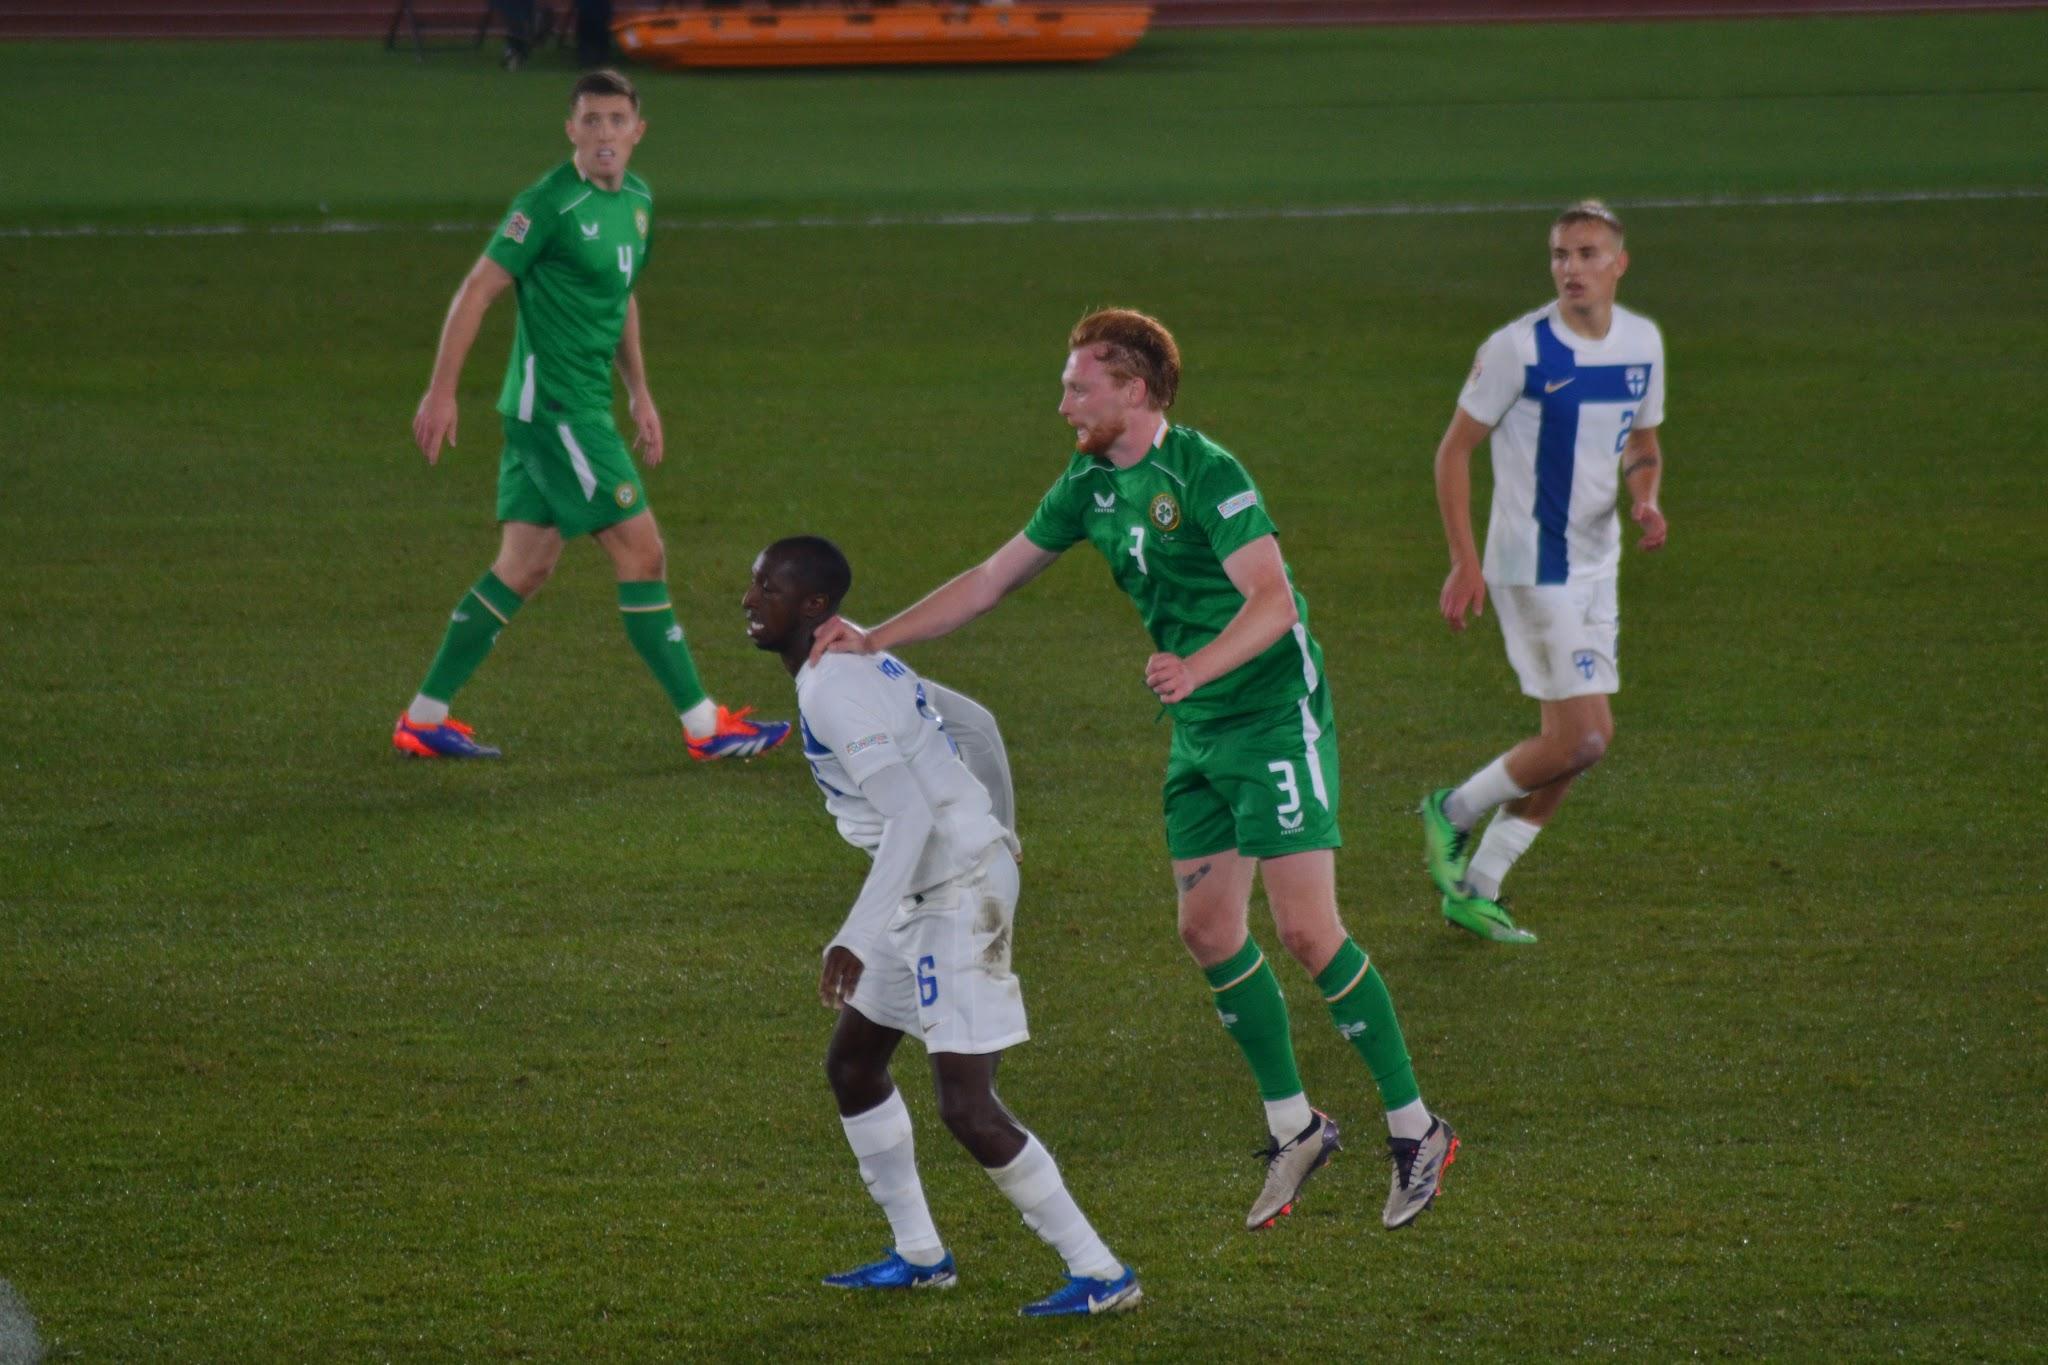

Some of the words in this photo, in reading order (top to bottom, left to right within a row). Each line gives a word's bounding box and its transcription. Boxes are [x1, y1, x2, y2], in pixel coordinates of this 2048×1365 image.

[617, 245, 632, 288] 4
[1615, 410, 1635, 454] 2
[1268, 761, 1300, 814] 3
[917, 955, 938, 1007] 6
